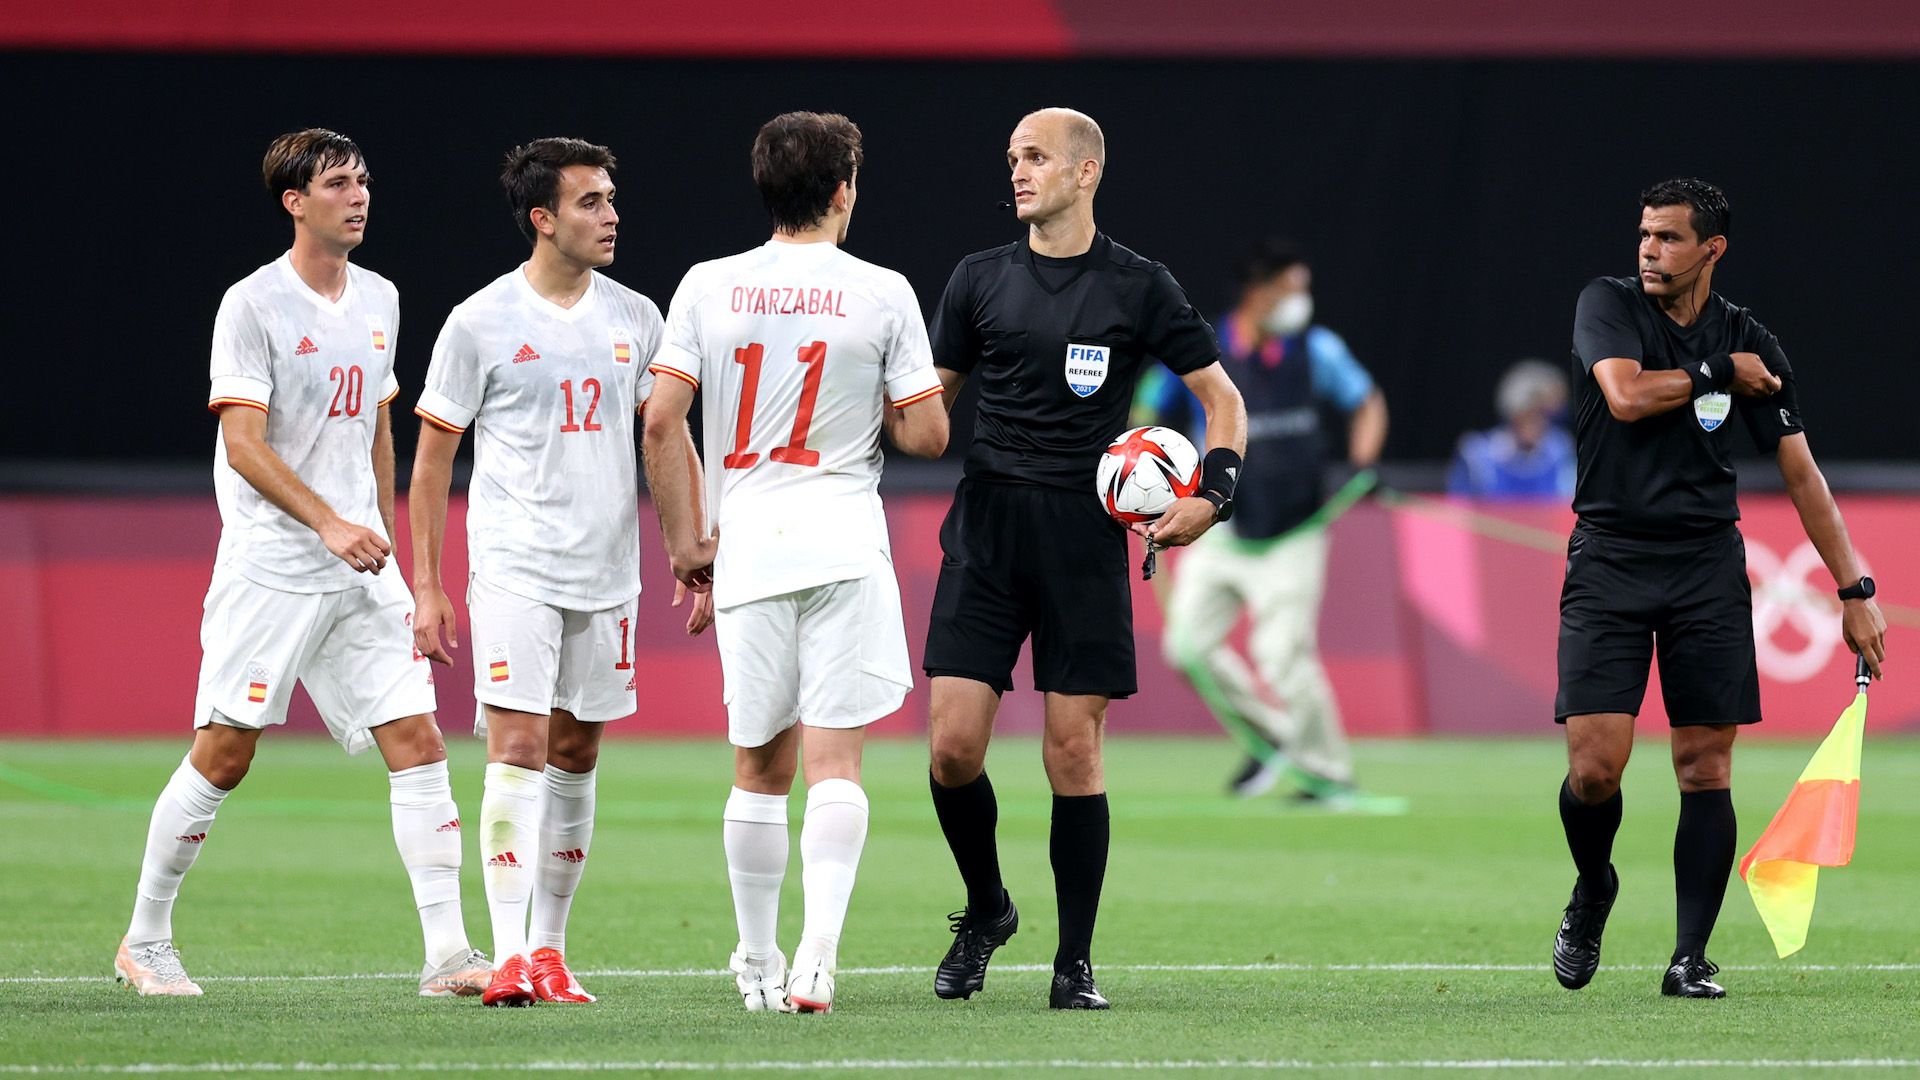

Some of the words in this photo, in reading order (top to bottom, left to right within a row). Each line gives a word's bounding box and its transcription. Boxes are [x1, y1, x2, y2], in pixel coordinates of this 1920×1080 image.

[731, 286, 847, 318] OYARZABAL
[294, 346, 319, 356] adidas
[512, 353, 541, 364] adidas
[1070, 347, 1104, 362] FIFA
[1068, 367, 1103, 377] REFEREE
[328, 364, 364, 417] 20
[1075, 385, 1092, 393] 2021
[560, 377, 602, 433] 12
[723, 340, 828, 470] 11
[615, 617, 633, 670] 1
